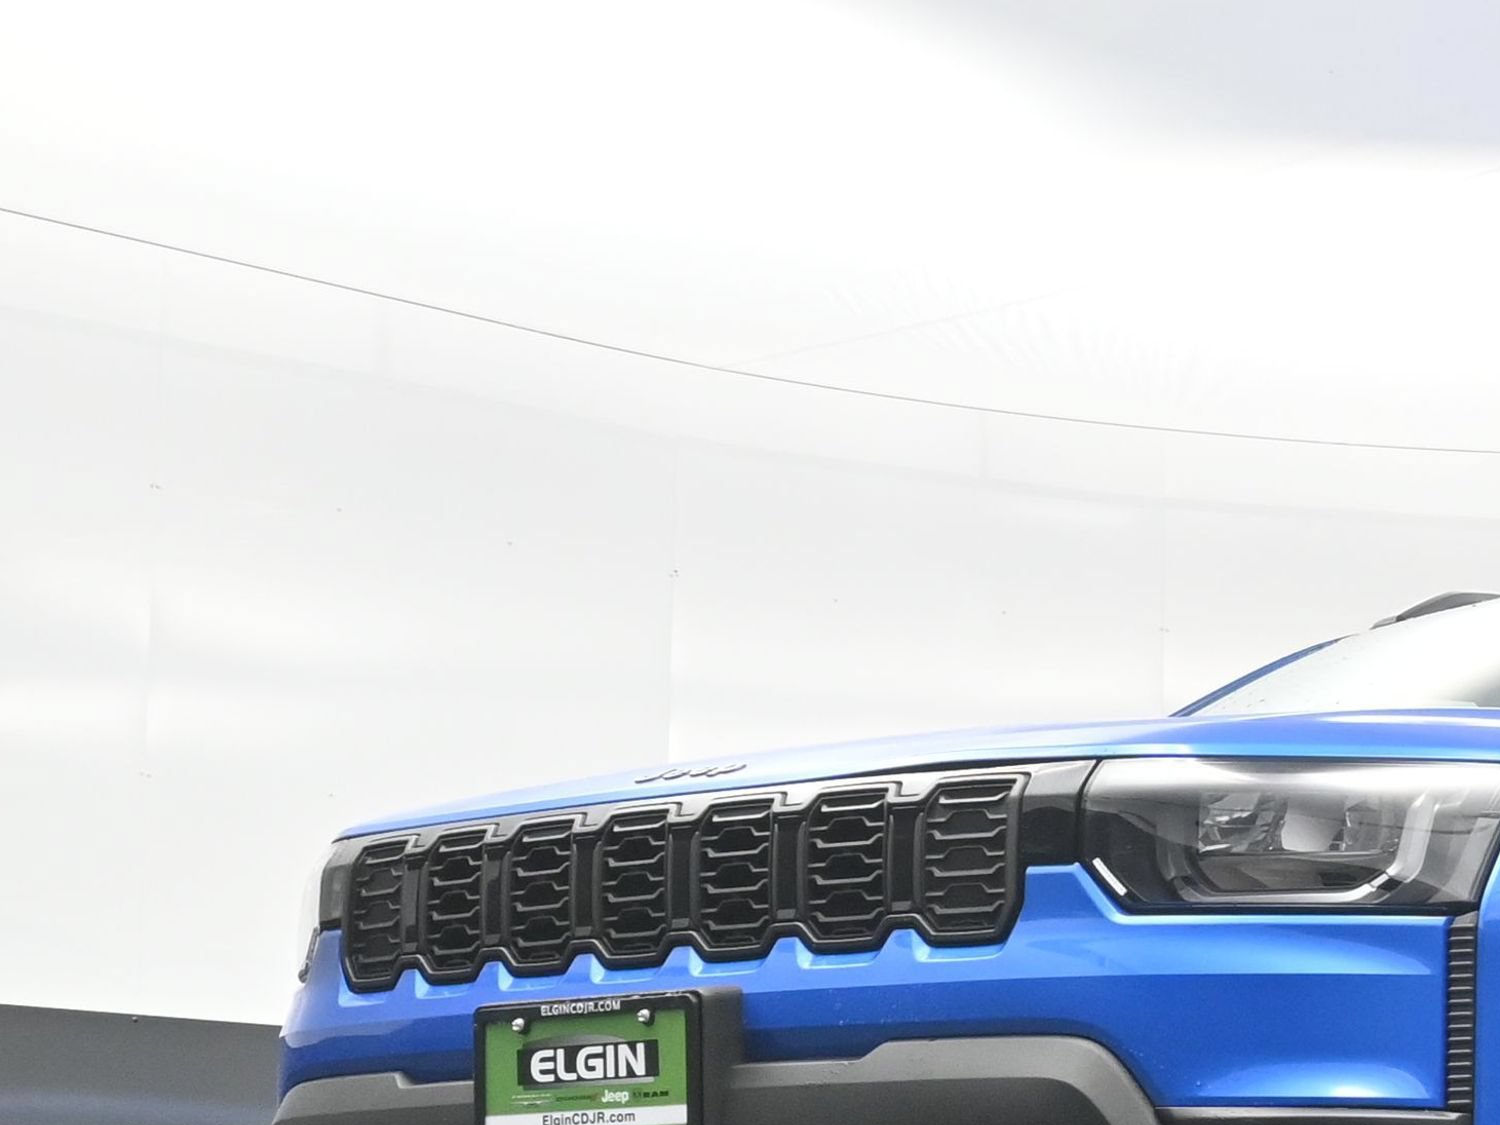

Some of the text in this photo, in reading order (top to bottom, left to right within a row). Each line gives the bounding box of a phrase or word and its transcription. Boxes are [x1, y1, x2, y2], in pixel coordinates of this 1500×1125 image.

[541, 1001, 621, 1016] ELGINCDJR.COM
[530, 1042, 646, 1084] ELGIN
[600, 1090, 629, 1104] Jeep
